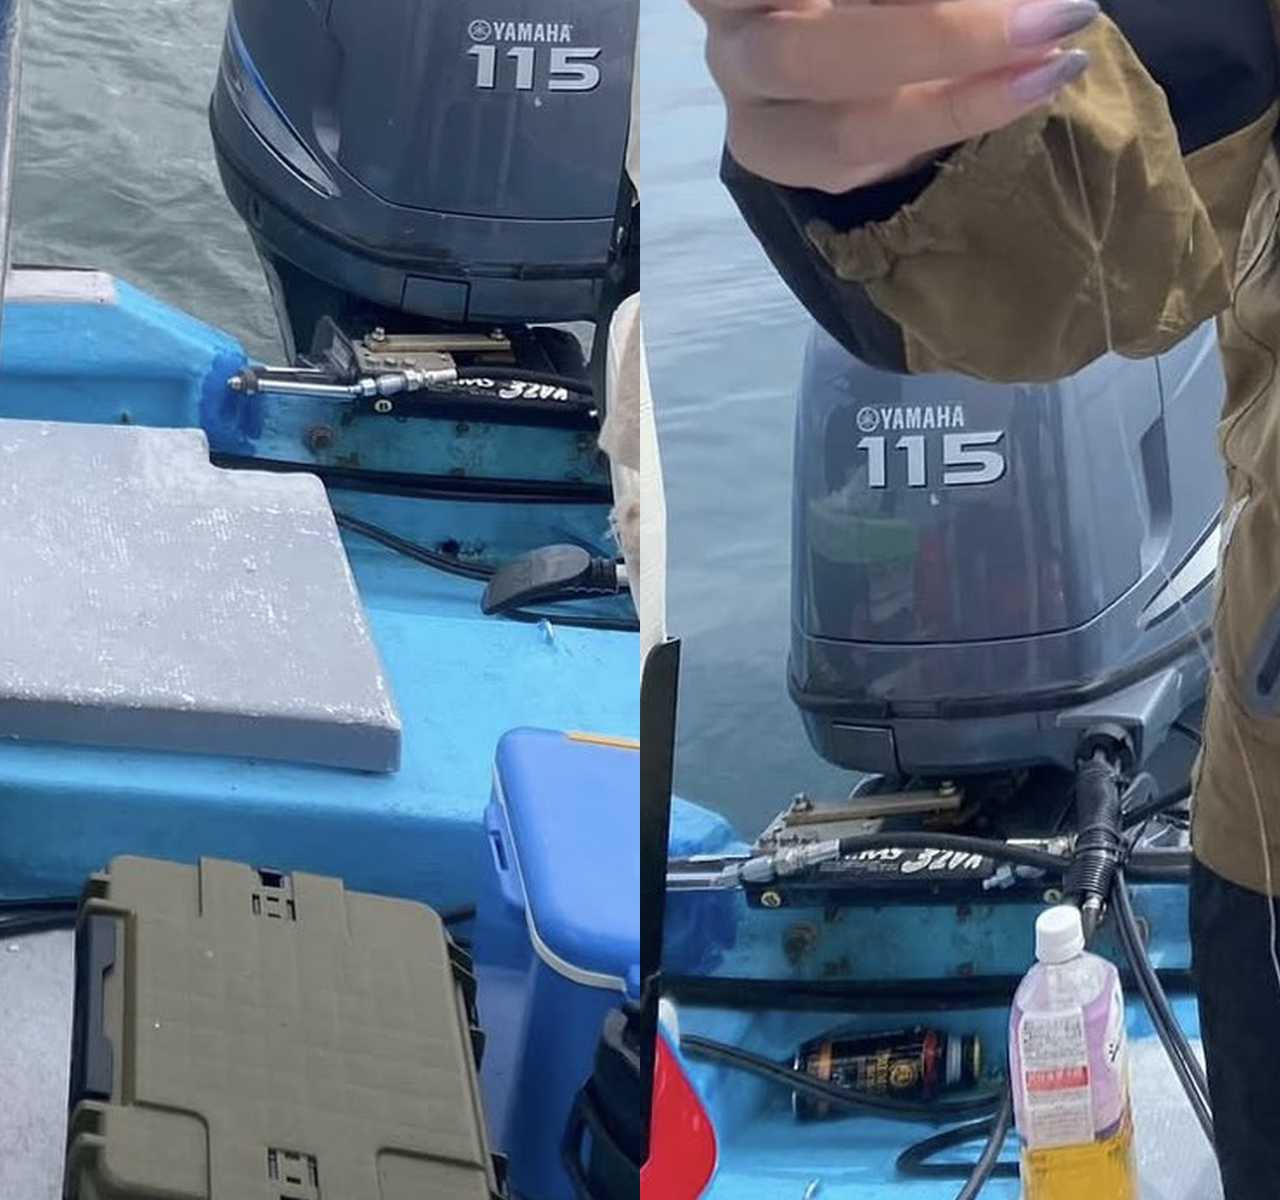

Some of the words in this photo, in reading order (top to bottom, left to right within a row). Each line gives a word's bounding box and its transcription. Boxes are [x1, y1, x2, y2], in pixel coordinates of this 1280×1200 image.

[493, 21, 572, 43] YAMAHA
[466, 44, 601, 92] 115
[879, 405, 965, 430] YAMAHA
[857, 430, 1006, 488] 115
